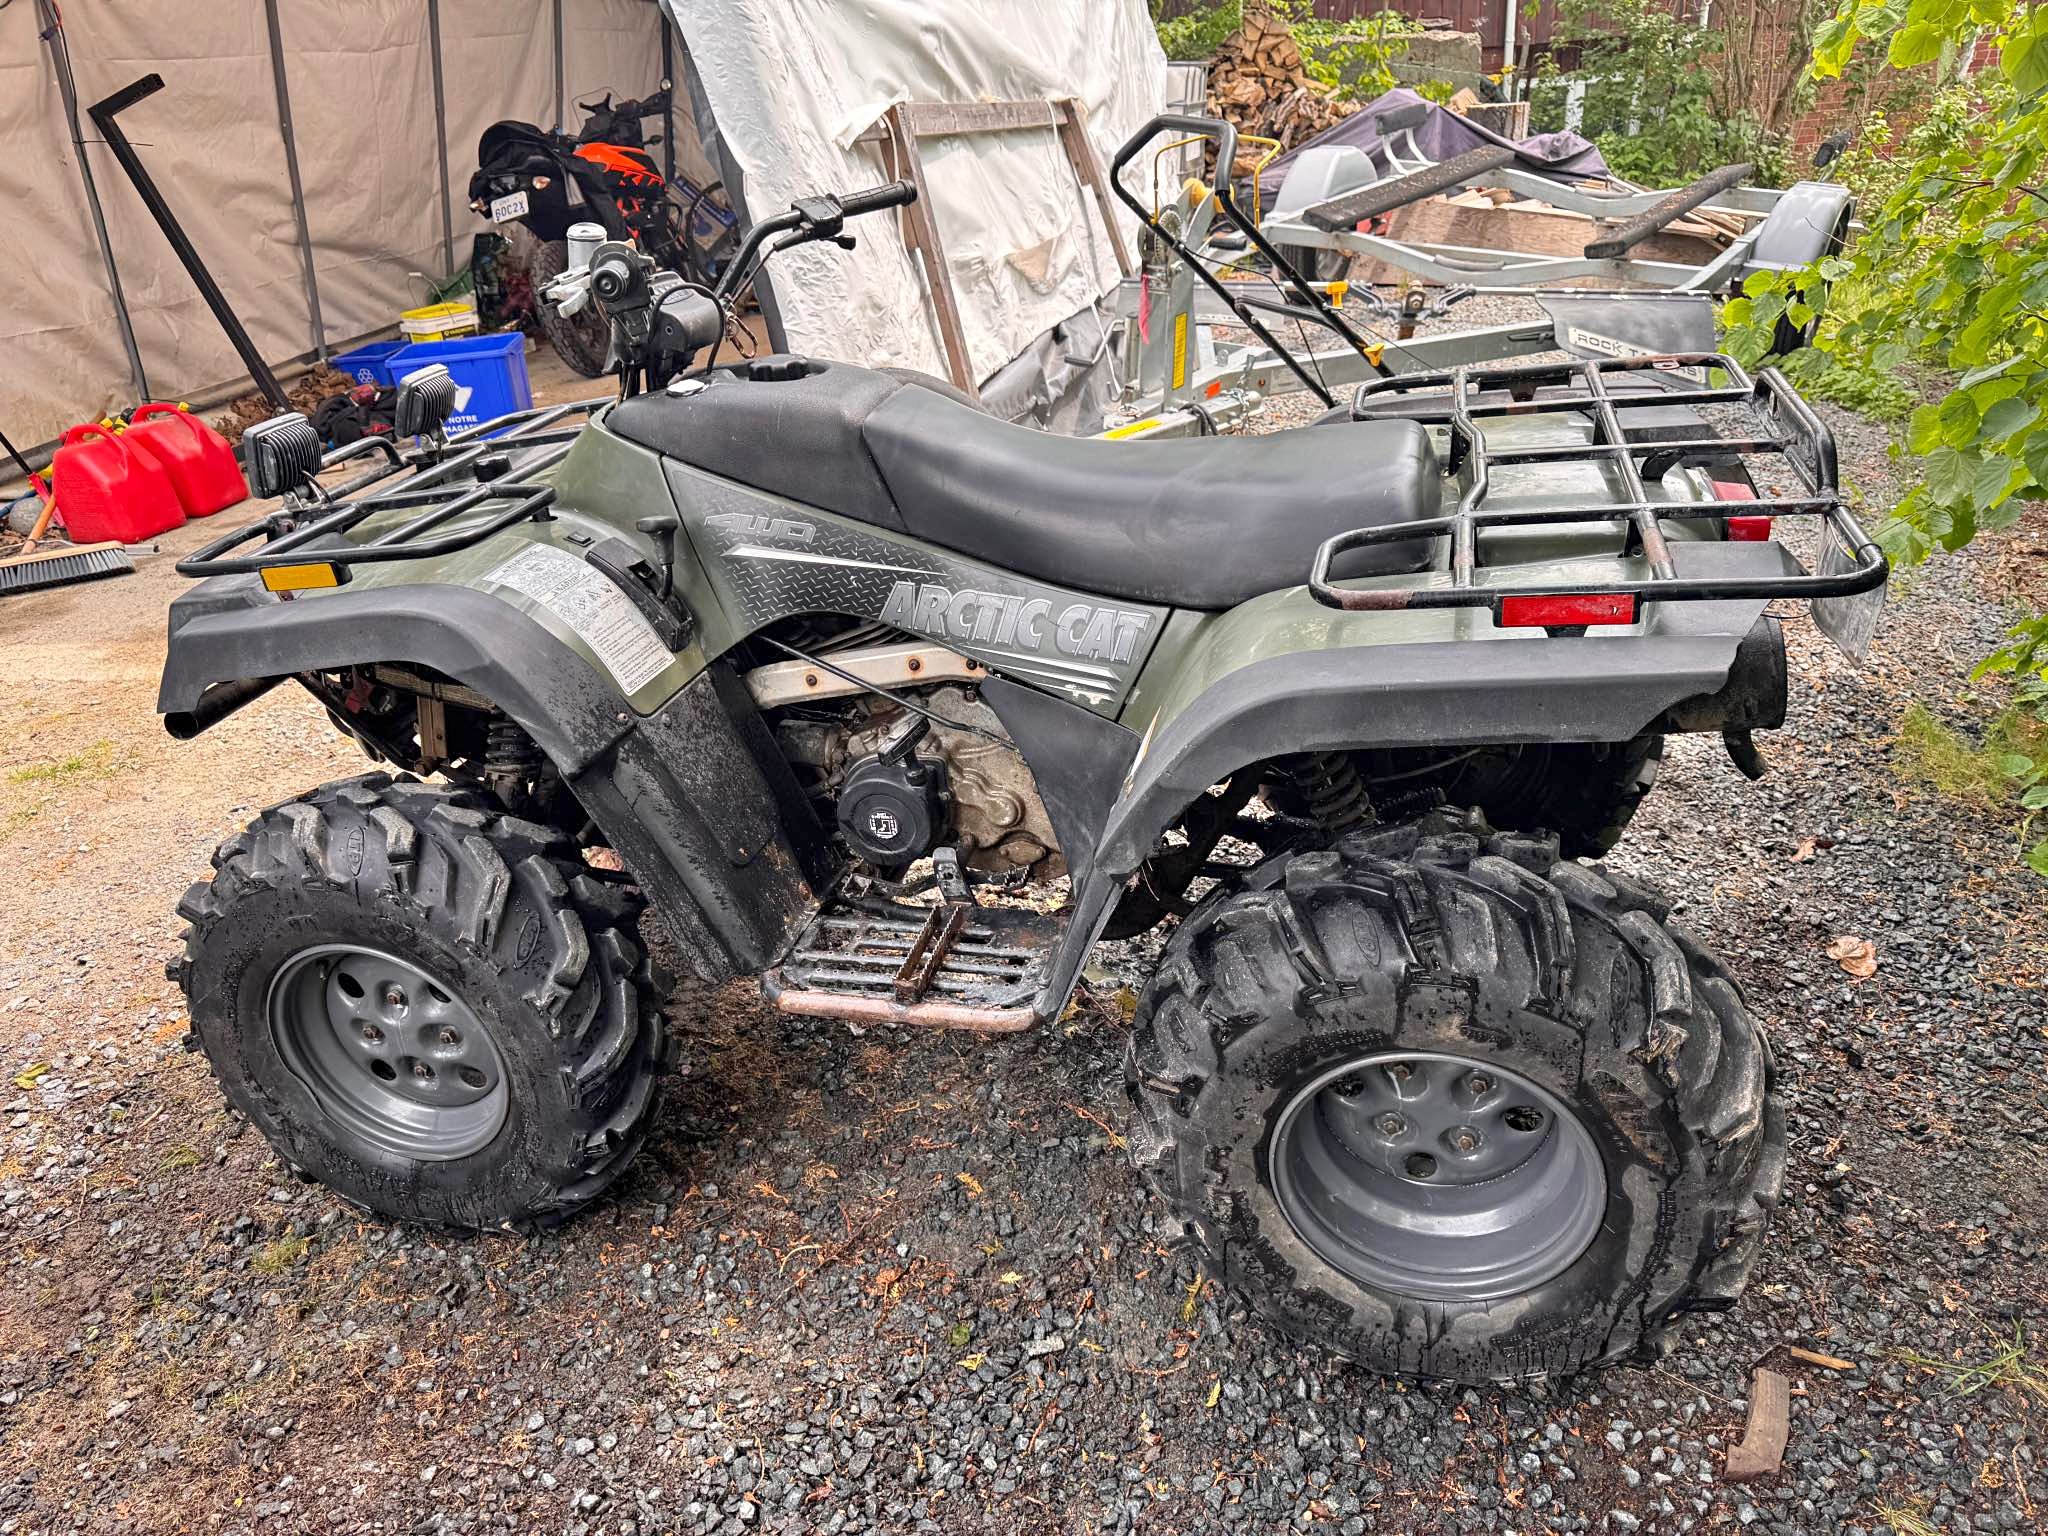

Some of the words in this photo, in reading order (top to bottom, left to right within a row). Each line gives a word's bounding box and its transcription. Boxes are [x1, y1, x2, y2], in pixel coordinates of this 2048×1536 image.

[1578, 334, 1622, 354] ROCK
[448, 415, 478, 423] NOTRE
[879, 578, 1052, 649] ARCTIC
[1055, 604, 1151, 664] CAT
